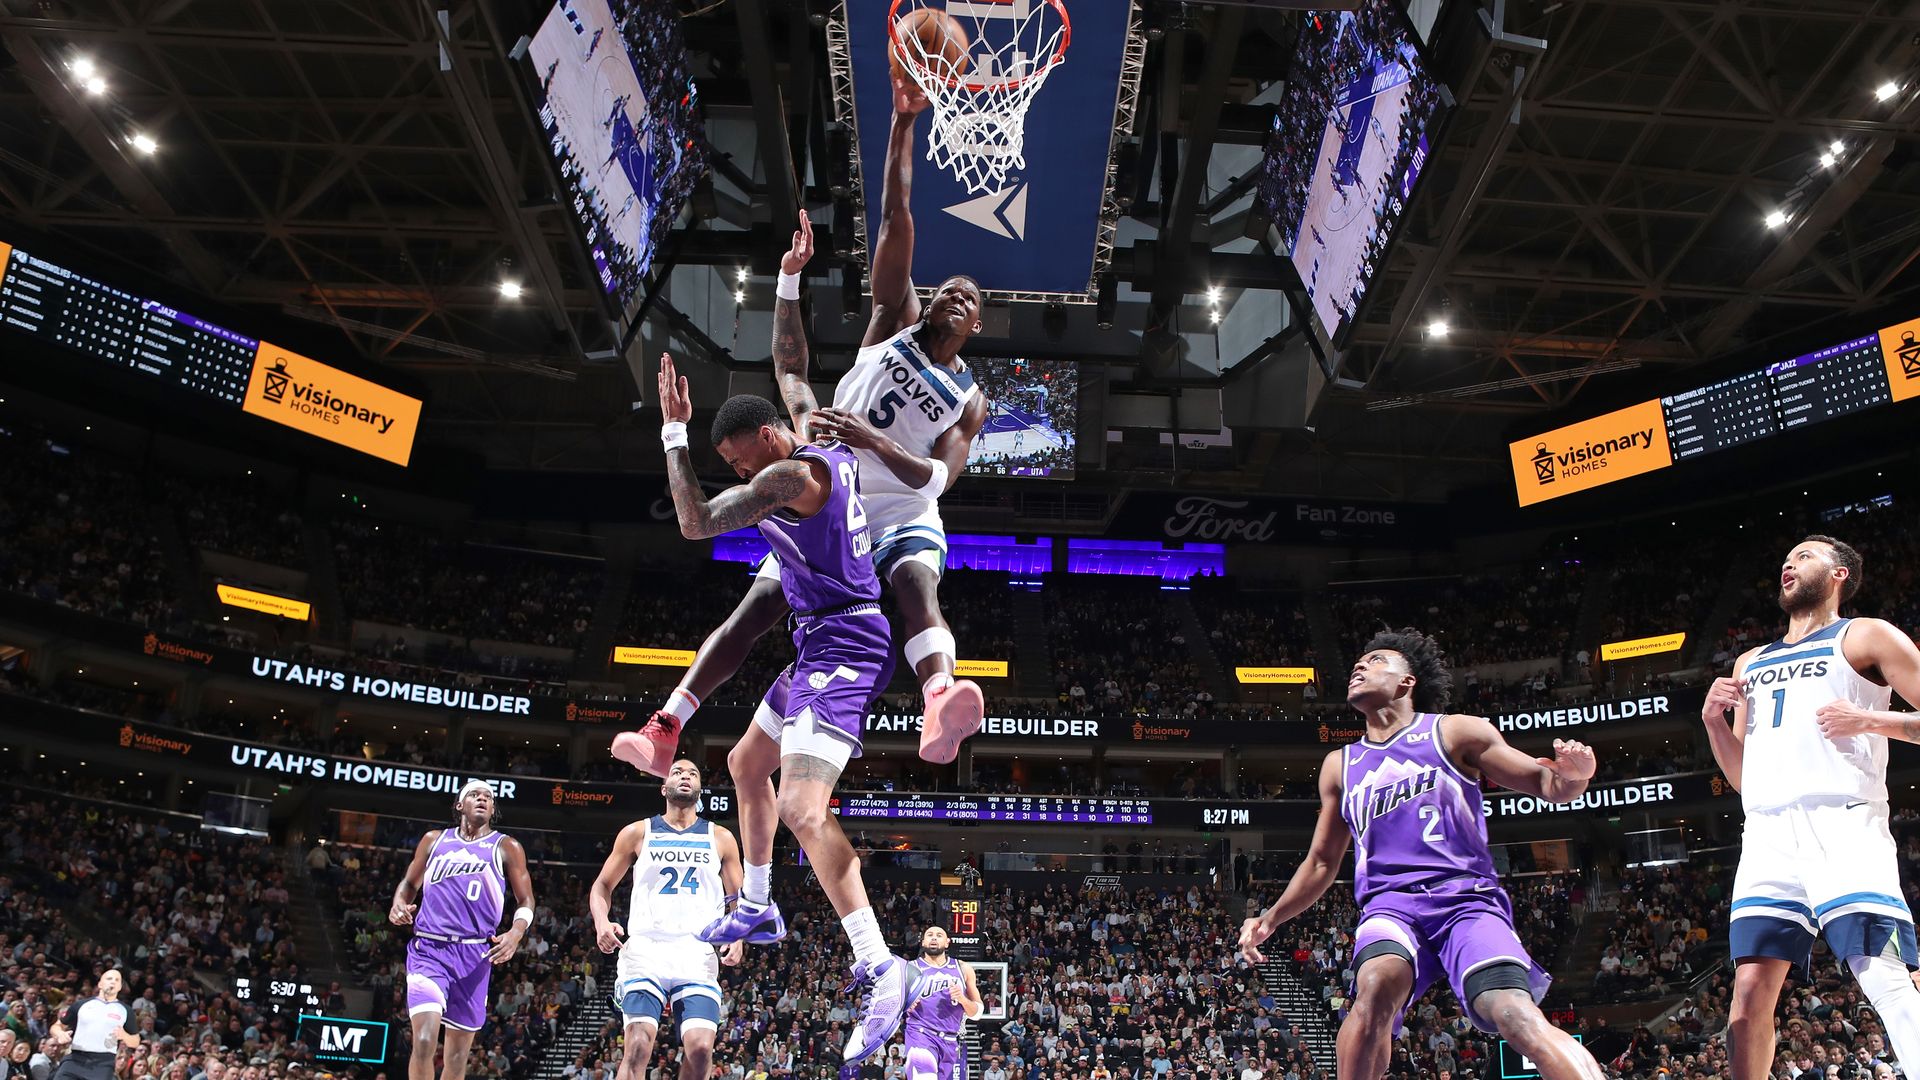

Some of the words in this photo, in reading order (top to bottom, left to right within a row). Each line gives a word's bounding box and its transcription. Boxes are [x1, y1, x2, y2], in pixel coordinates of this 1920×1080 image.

[561, 160, 572, 178] 65
[1365, 262, 1374, 278] 65
[1393, 198, 1402, 216] 66
[1412, 146, 1426, 170] UTA
[158, 306, 178, 318] JAZZ
[1780, 359, 1797, 371] JAZZ
[1778, 371, 1797, 380] SEXTON
[879, 351, 944, 422] WOLVES
[944, 380, 959, 396] AURA
[1780, 378, 1815, 392] HORTON-TUCKER
[1674, 387, 1706, 402] TIMBERWOLVES
[1782, 394, 1803, 404] COLLINS
[290, 400, 340, 425] HOMES
[293, 383, 394, 434] visionary
[868, 390, 906, 429] 5
[1784, 403, 1812, 415] HENDRICKS
[1674, 415, 1692, 423] MORRIS
[1787, 417, 1808, 426] GEORGE
[1676, 425, 1696, 434] WARREN
[1557, 428, 1653, 467] visionary
[1679, 435, 1704, 446] ANDERSON
[1681, 446, 1704, 457] EDWARDS
[970, 466, 981, 474] 5:30
[1030, 468, 1044, 476] UTA
[1562, 458, 1608, 478] HOMES
[838, 460, 868, 532] 2
[1164, 496, 1278, 542] Ford
[1296, 504, 1336, 522] Fan
[1342, 506, 1395, 524] Zone
[226, 592, 300, 613] VisionaryHomes.com
[158, 642, 213, 664] visionary
[1609, 639, 1677, 655] VisionaryHomes.com
[623, 652, 688, 661] VisionaryHomes.com
[955, 664, 1000, 673] aryHomes.com
[1747, 661, 1828, 690] WOLVES
[252, 657, 345, 691] UTAH'S
[352, 676, 531, 715] HOMEBUILDER
[578, 706, 626, 721] visionary
[1499, 696, 1669, 731] HOMEBUILDER
[1772, 688, 1785, 728] 1
[866, 714, 924, 731] TAH'S
[1144, 726, 1190, 739] visionary
[1330, 728, 1367, 737] visiona
[1406, 732, 1431, 743] LVT
[135, 734, 192, 755] visionary
[231, 745, 326, 778] UTAH'S
[334, 762, 516, 799] HOMEBUILER
[564, 790, 613, 804] visionary
[710, 796, 728, 811] 65
[1350, 768, 1440, 842] UTAH
[1203, 809, 1228, 824] 8:27
[1231, 809, 1249, 825] PM
[1419, 804, 1444, 842] 2
[650, 851, 709, 863] WOLVES
[430, 859, 488, 884] UTAH
[659, 866, 699, 894] 24
[466, 880, 482, 902] 0
[951, 901, 978, 913] 5:30
[954, 913, 974, 934] 19
[237, 988, 250, 998] 65
[270, 981, 296, 996] 5:30
[306, 995, 319, 1005] 66
[320, 1025, 368, 1053] LVT
